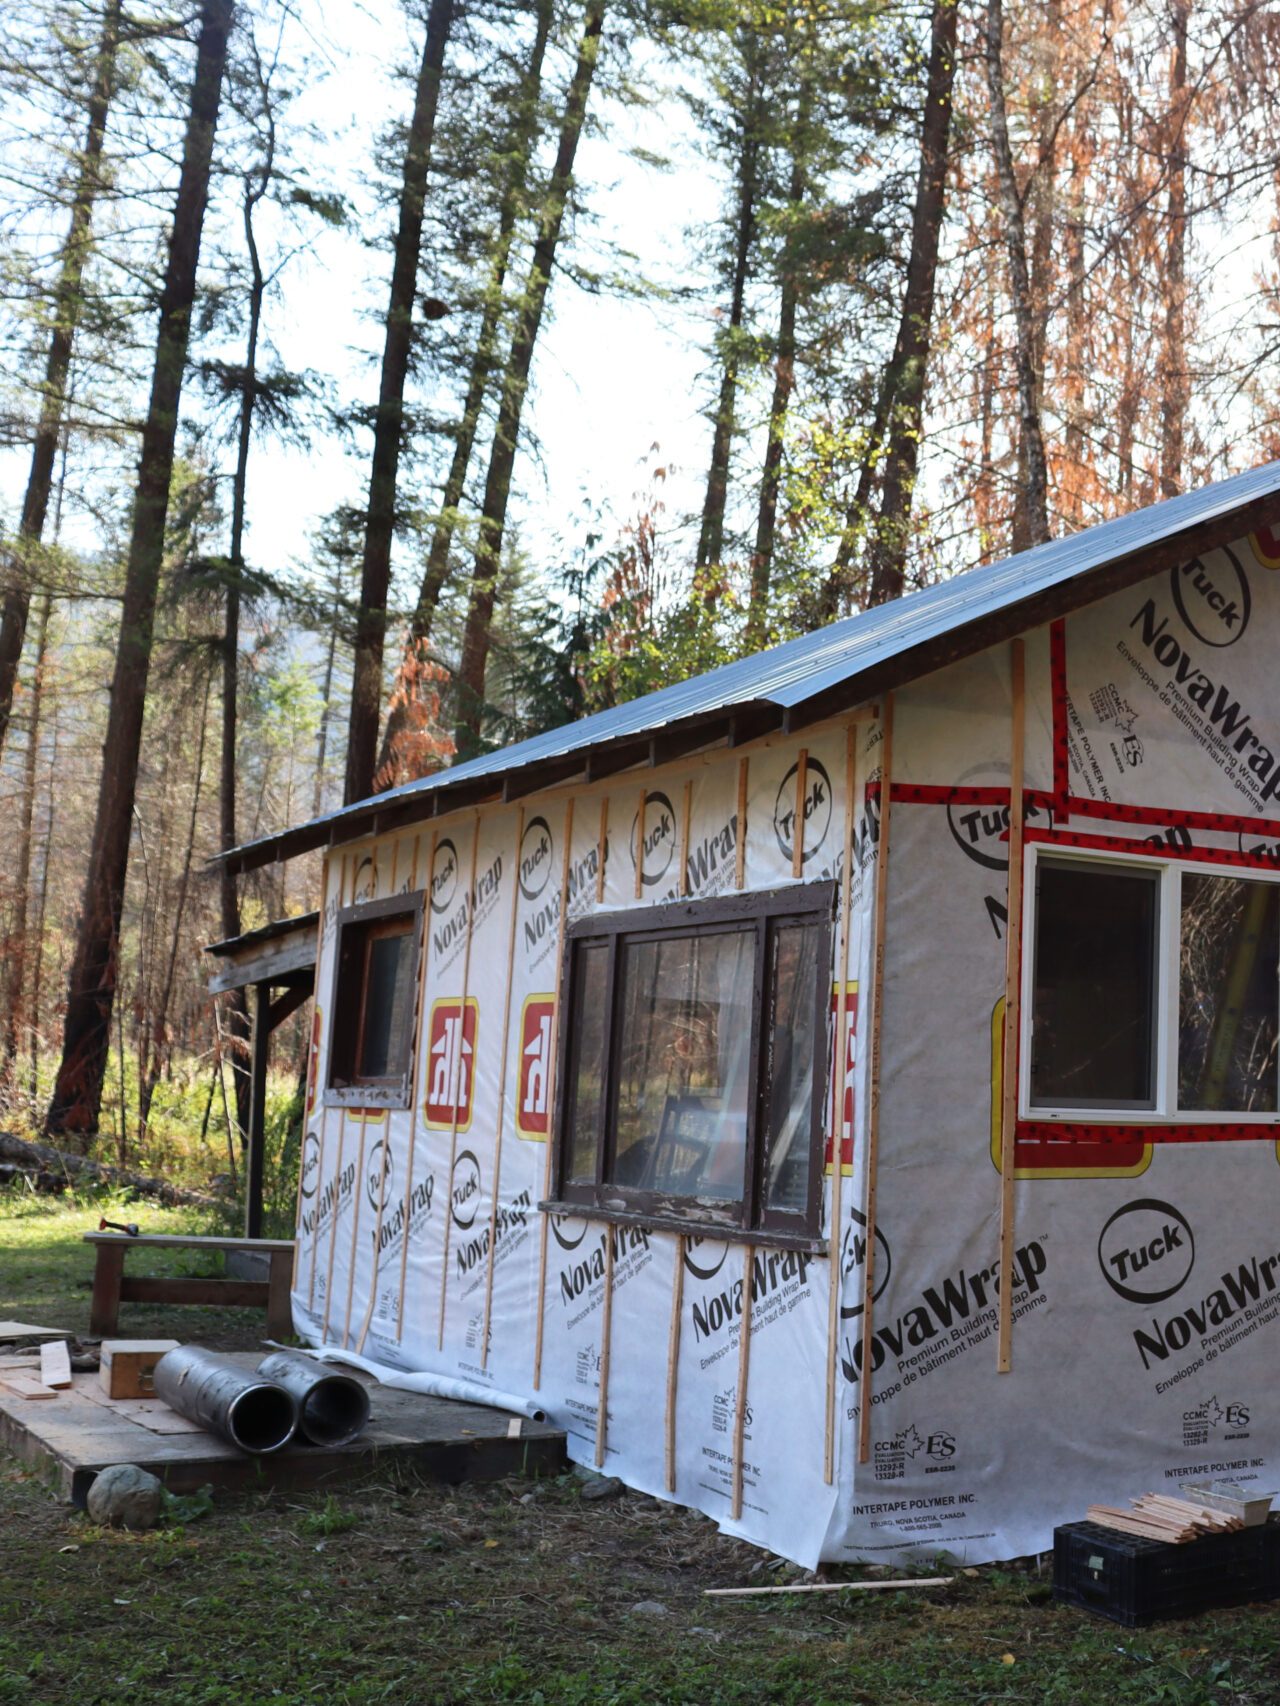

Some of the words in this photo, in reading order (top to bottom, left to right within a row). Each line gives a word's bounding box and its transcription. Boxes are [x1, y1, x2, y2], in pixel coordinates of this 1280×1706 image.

[1116, 640, 1159, 693] Enveloppe
[1159, 690, 1172, 706] de
[1171, 703, 1208, 746] bâtiment
[1206, 742, 1225, 767] haut
[1224, 765, 1236, 780] de
[1235, 778, 1264, 813] gamme
[1165, 681, 1204, 729] Premium
[1204, 724, 1238, 768] Building
[1238, 765, 1261, 792] Wrap
[521, 836, 549, 883] Tuck
[1110, 1225, 1184, 1282] Tuck
[897, 1338, 949, 1373] Premium
[950, 1308, 997, 1341] Building
[1200, 1318, 1244, 1350] Premium
[903, 1367, 917, 1386] de
[919, 1341, 966, 1376] bâtiment
[967, 1326, 992, 1349] haut
[1155, 1358, 1204, 1394] Enveloppe
[1206, 1348, 1218, 1362] de
[1219, 1324, 1258, 1353] bâtiment
[1259, 1307, 1279, 1327] haut
[1183, 1410, 1208, 1420] CCMC
[1226, 1405, 1250, 1425] ES
[874, 1441, 906, 1451] CCMC
[926, 1435, 956, 1457] ES
[1165, 1465, 1209, 1478] INTERTAPE
[1211, 1460, 1248, 1472] POLYMER
[1250, 1458, 1267, 1468] INC.
[853, 1501, 907, 1515] INTERTAPE
[909, 1495, 955, 1510] POLYMER
[958, 1493, 978, 1504] INC.
[895, 1517, 913, 1526] NOVA
[939, 1511, 966, 1521] CANADA
